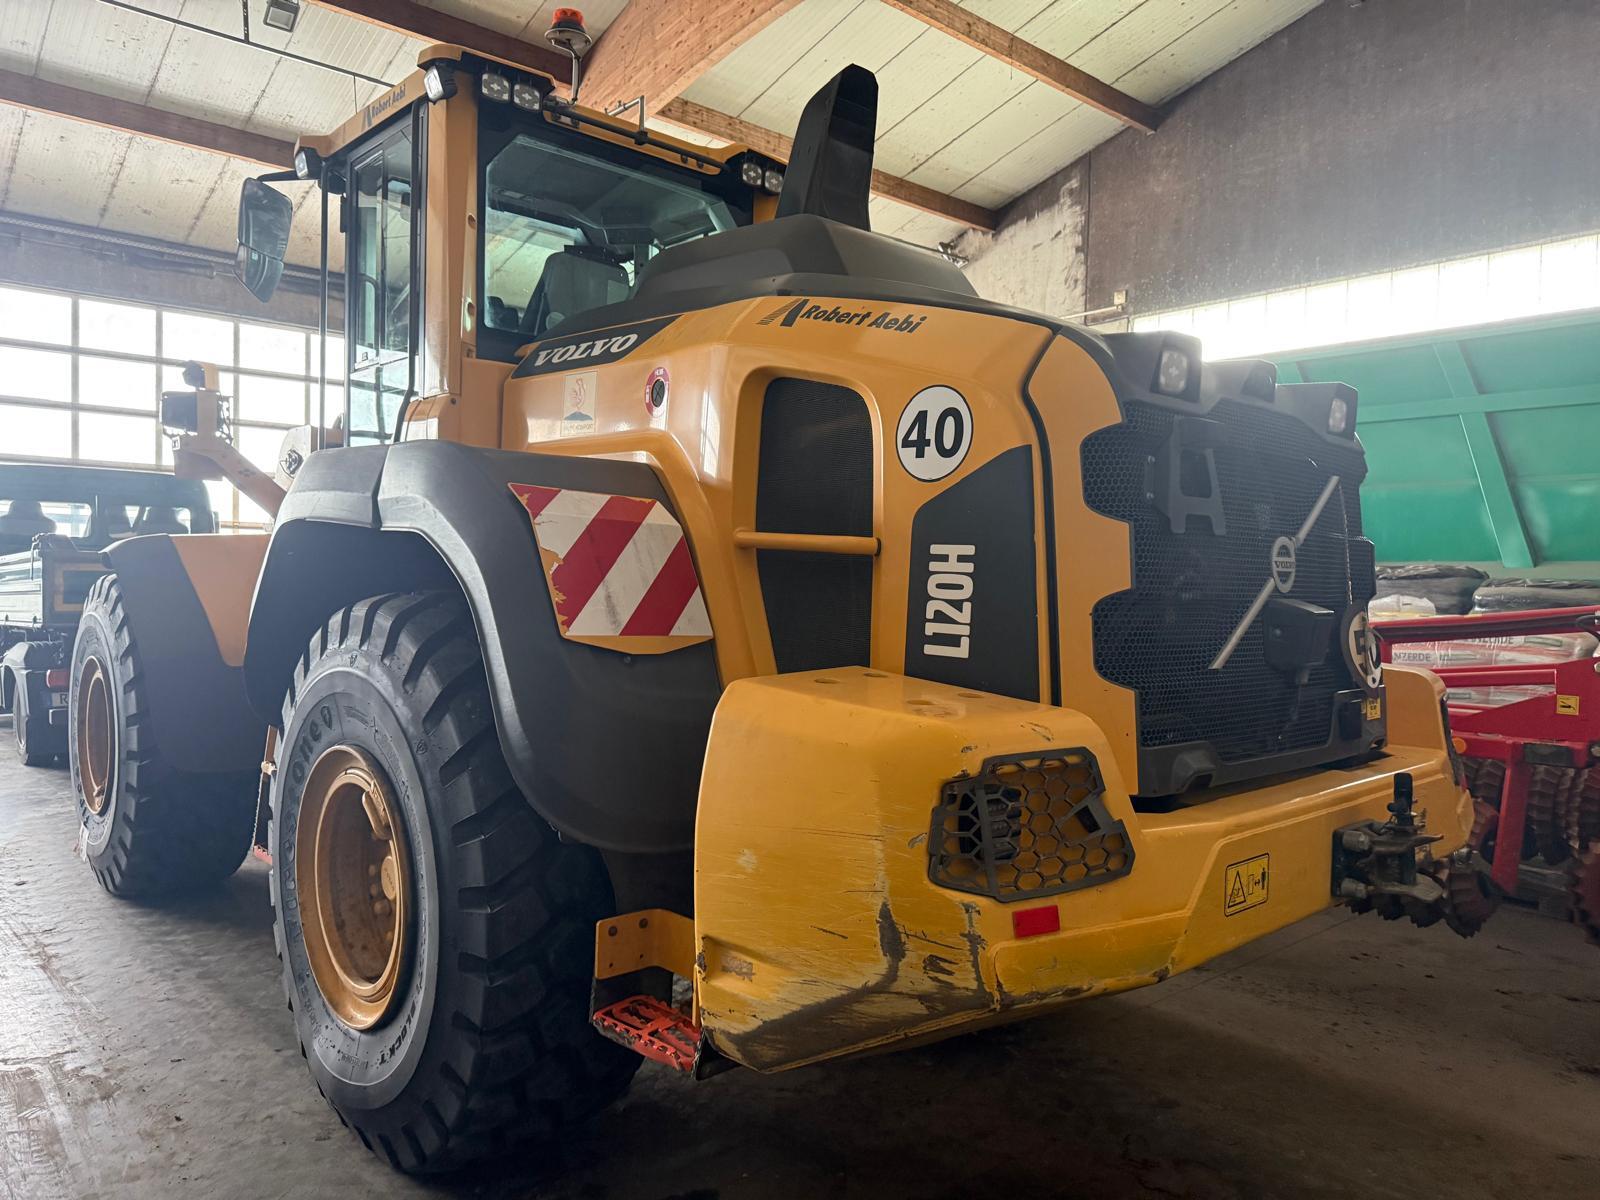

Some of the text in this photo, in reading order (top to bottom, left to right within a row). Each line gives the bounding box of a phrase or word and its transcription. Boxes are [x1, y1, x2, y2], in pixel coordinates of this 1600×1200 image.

[371, 95, 391, 118] Robert
[800, 304, 927, 334] Robert Aebi
[533, 333, 638, 367] VOLVO
[901, 406, 964, 459] 40
[923, 543, 976, 659] L120H
